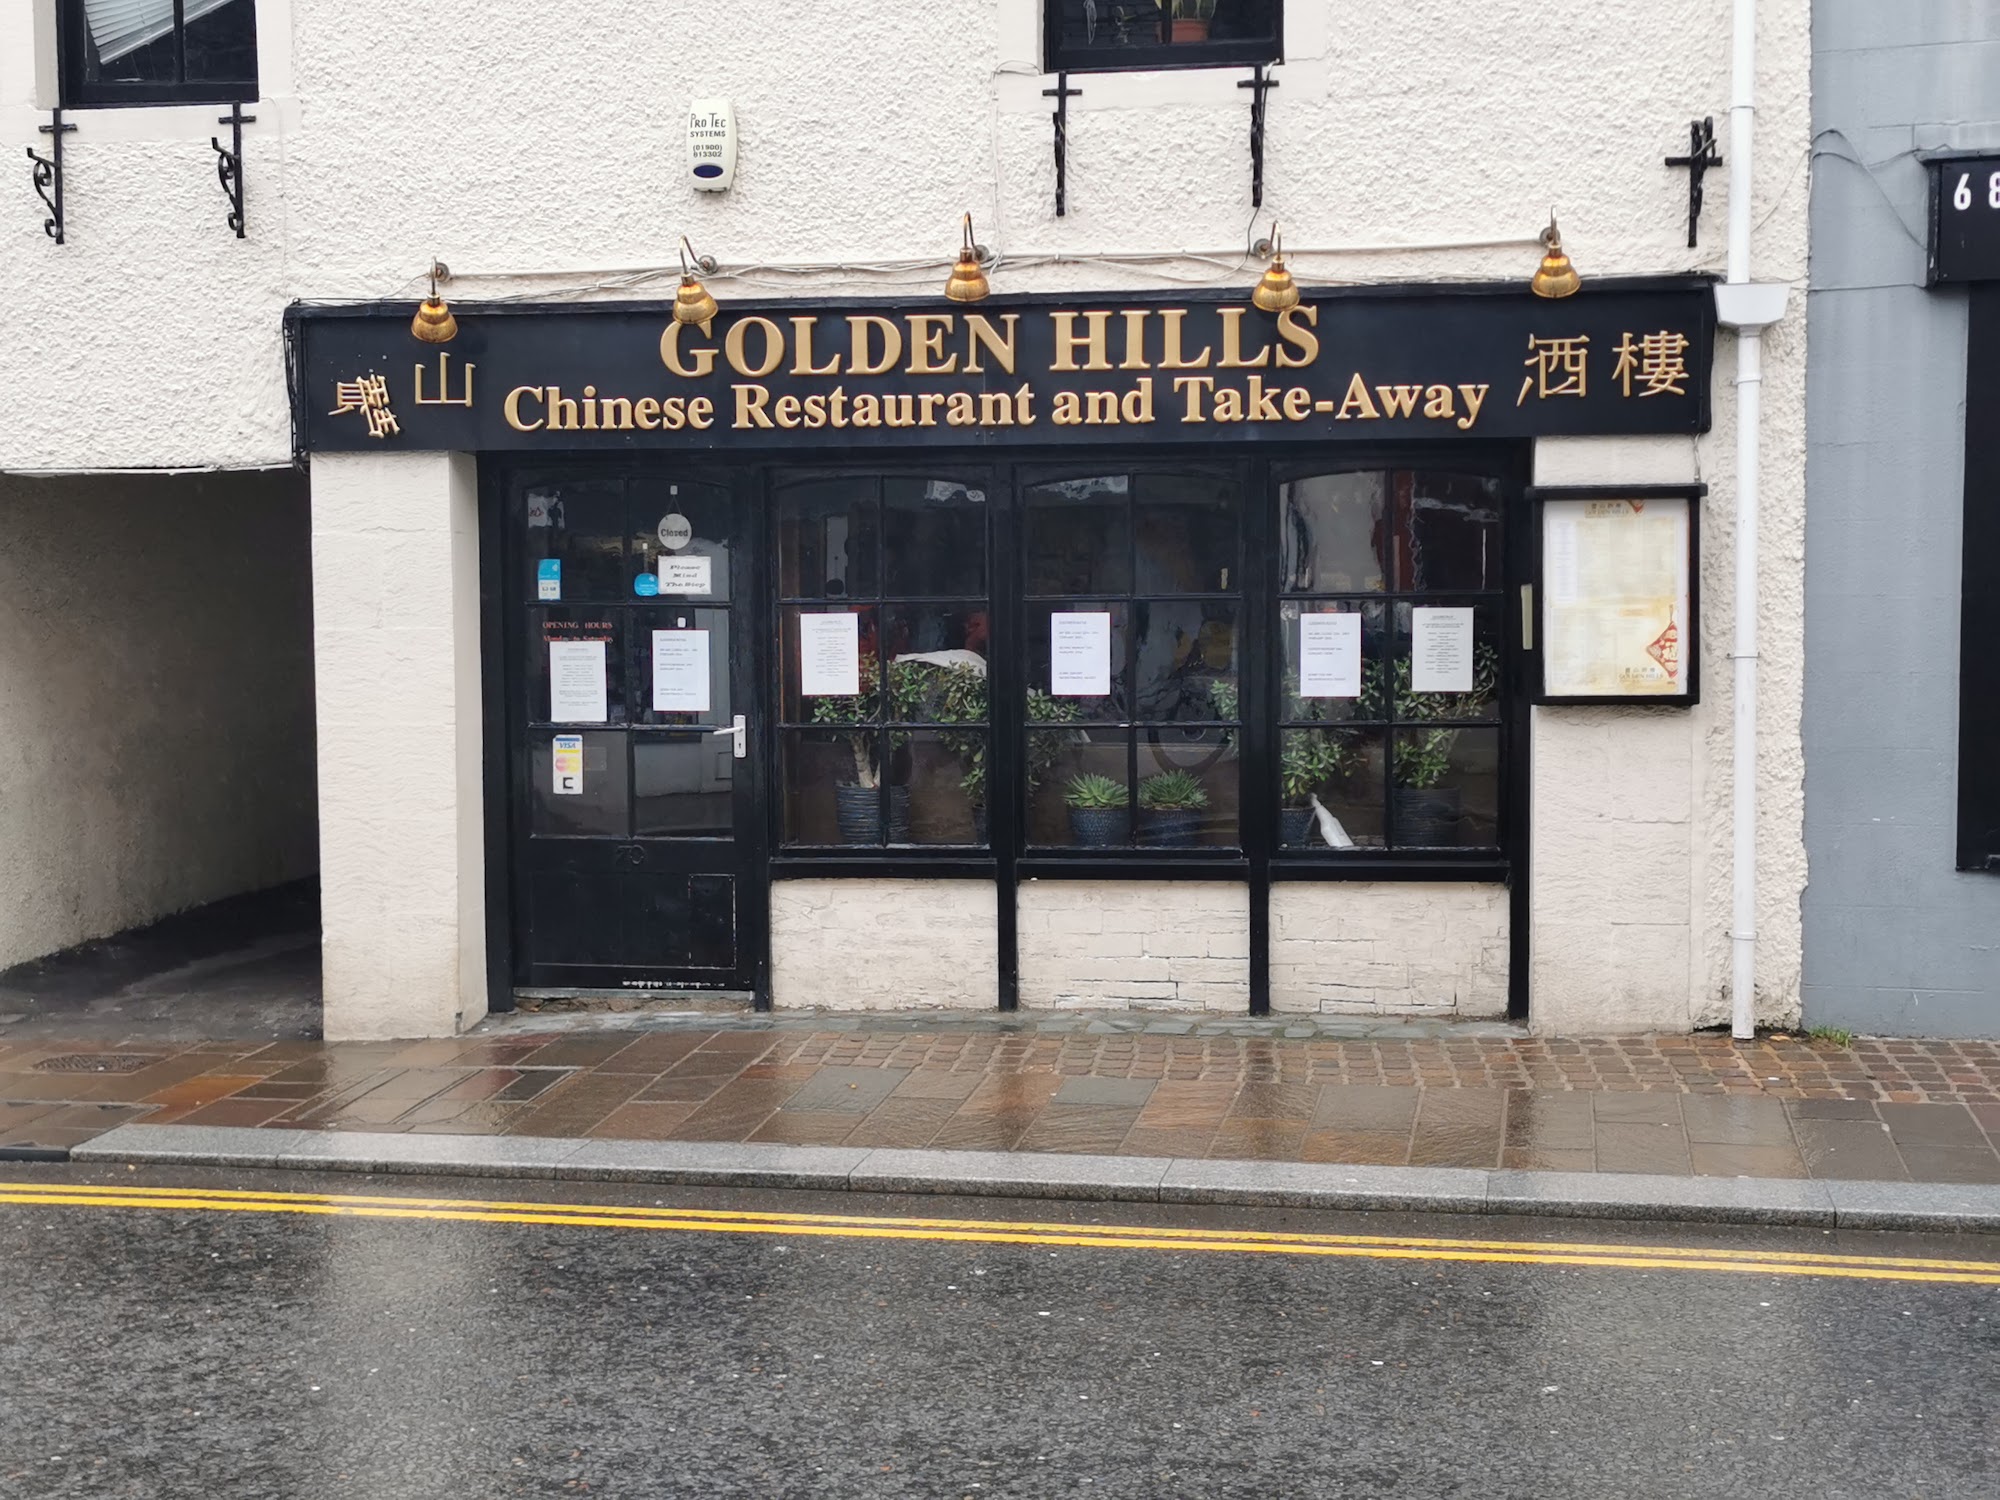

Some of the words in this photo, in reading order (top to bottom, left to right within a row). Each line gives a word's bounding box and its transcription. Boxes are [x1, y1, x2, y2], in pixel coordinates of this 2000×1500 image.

[690, 113, 707, 128] PRO
[708, 112, 727, 128] TEC
[690, 130, 726, 138] SYSTEMS
[692, 144, 723, 152] (01900)
[660, 312, 1020, 378] GOLDEN
[1049, 304, 1319, 371] HILLS
[503, 385, 714, 432] Chinese
[730, 382, 1037, 430] Restaurant
[1051, 377, 1156, 426] and
[1173, 372, 1490, 431] Take-Away
[660, 528, 689, 538] Closed
[542, 621, 579, 630] OPENING
[584, 621, 614, 630] HOURS
